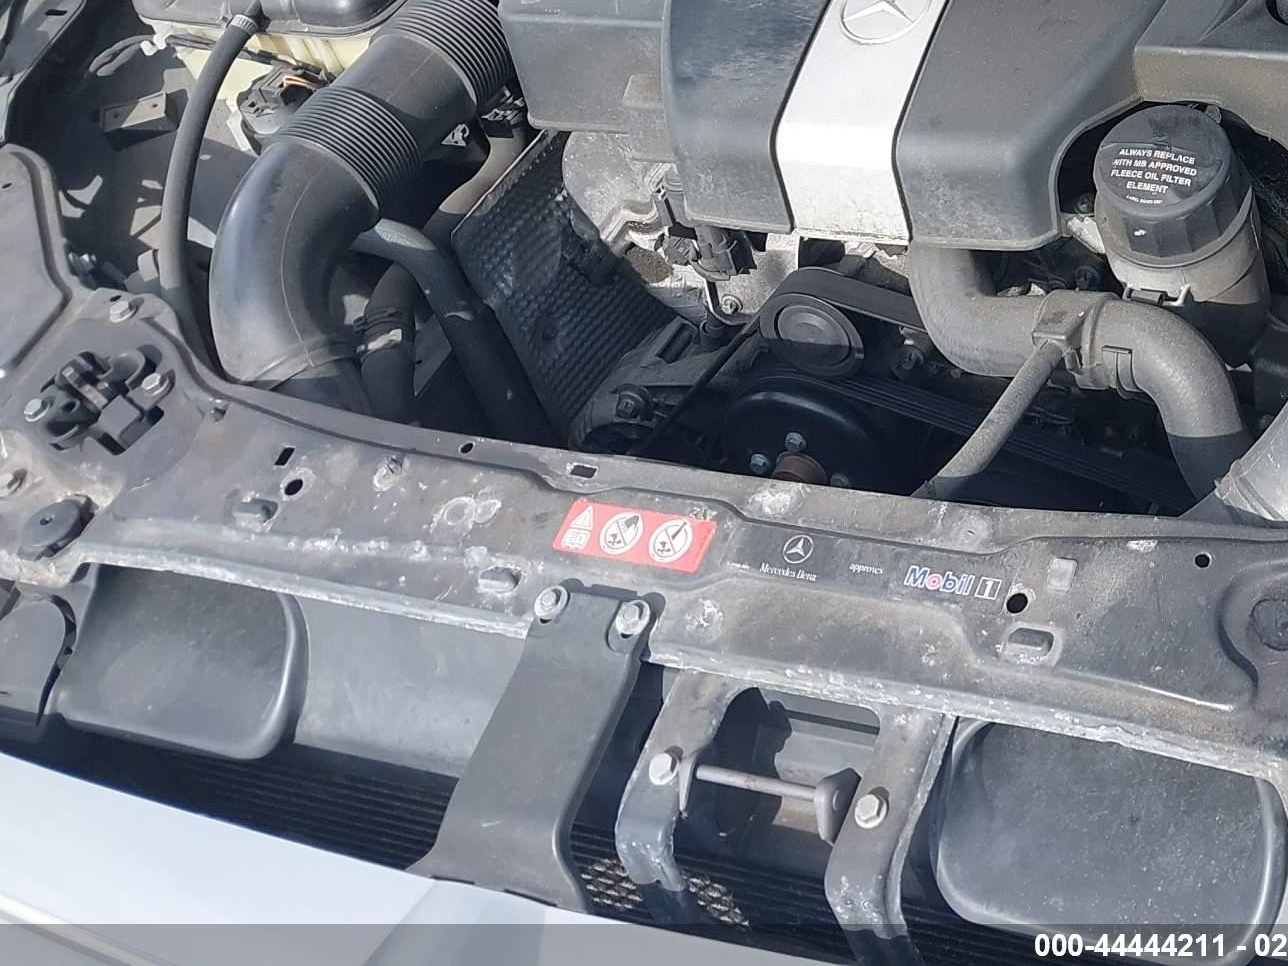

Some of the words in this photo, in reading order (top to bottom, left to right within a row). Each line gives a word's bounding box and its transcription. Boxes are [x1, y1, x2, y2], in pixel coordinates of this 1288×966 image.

[1119, 148, 1152, 158] ALWAYS
[1153, 149, 1196, 165] REPLACE
[1133, 160, 1147, 168] MB
[1148, 160, 1198, 176] APPROVED
[1110, 169, 1143, 179] FLEECE
[1144, 171, 1159, 181] OIL
[1160, 174, 1192, 187] FILTER
[1126, 181, 1169, 194] ELEMENT
[903, 565, 976, 596] Mobil
